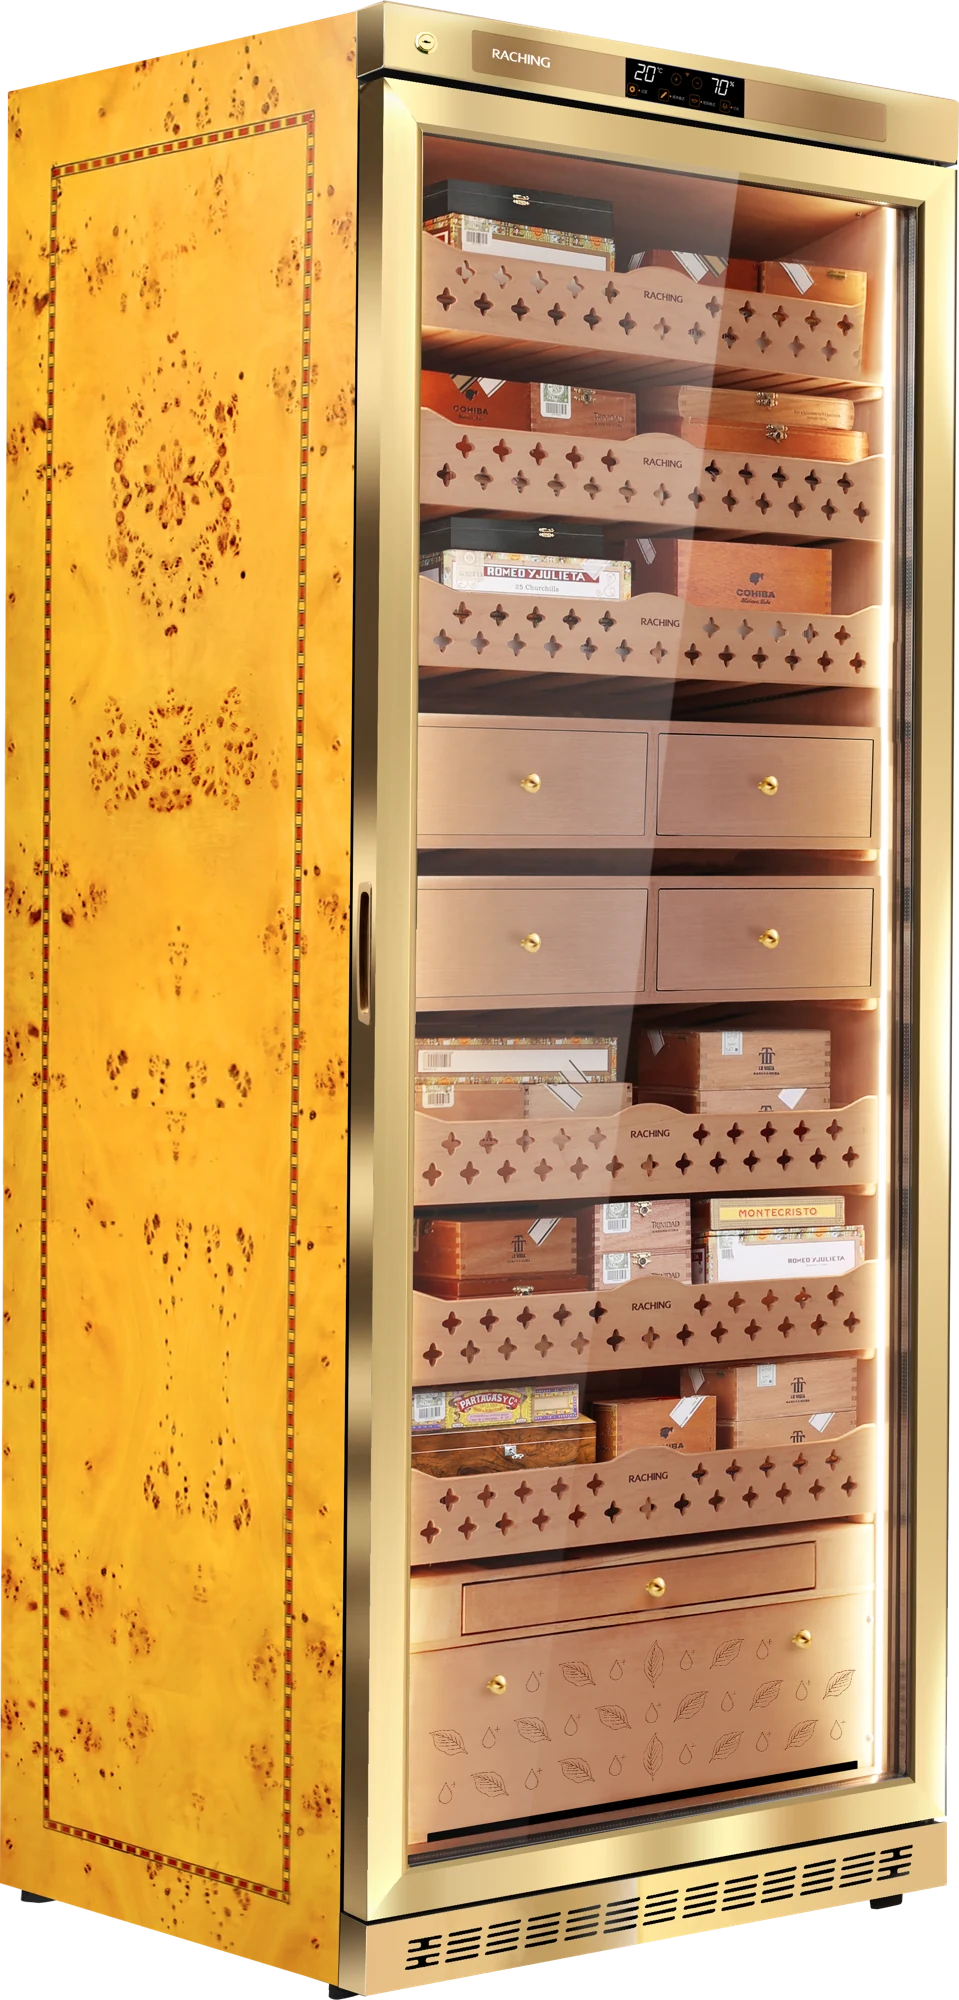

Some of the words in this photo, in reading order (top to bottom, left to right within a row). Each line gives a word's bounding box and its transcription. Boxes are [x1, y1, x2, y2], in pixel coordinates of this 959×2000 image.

[492, 48, 550, 68] RACHING
[644, 290, 683, 303] RACHING
[453, 405, 488, 415] COHIBA
[643, 457, 682, 468] RACHING
[487, 566, 526, 577] ROMEO
[515, 583, 524, 591] 25
[525, 584, 560, 593] Churchills
[736, 588, 775, 598] COHIBA
[640, 617, 680, 628] RACHING
[630, 1128, 670, 1138] RACHING
[738, 1207, 818, 1218] MONTECRISTO
[651, 1220, 680, 1229] TRINIDAD
[631, 1300, 672, 1311] RACHING
[459, 1393, 503, 1410] PARTAGAS
[628, 1471, 669, 1483] RACHING
